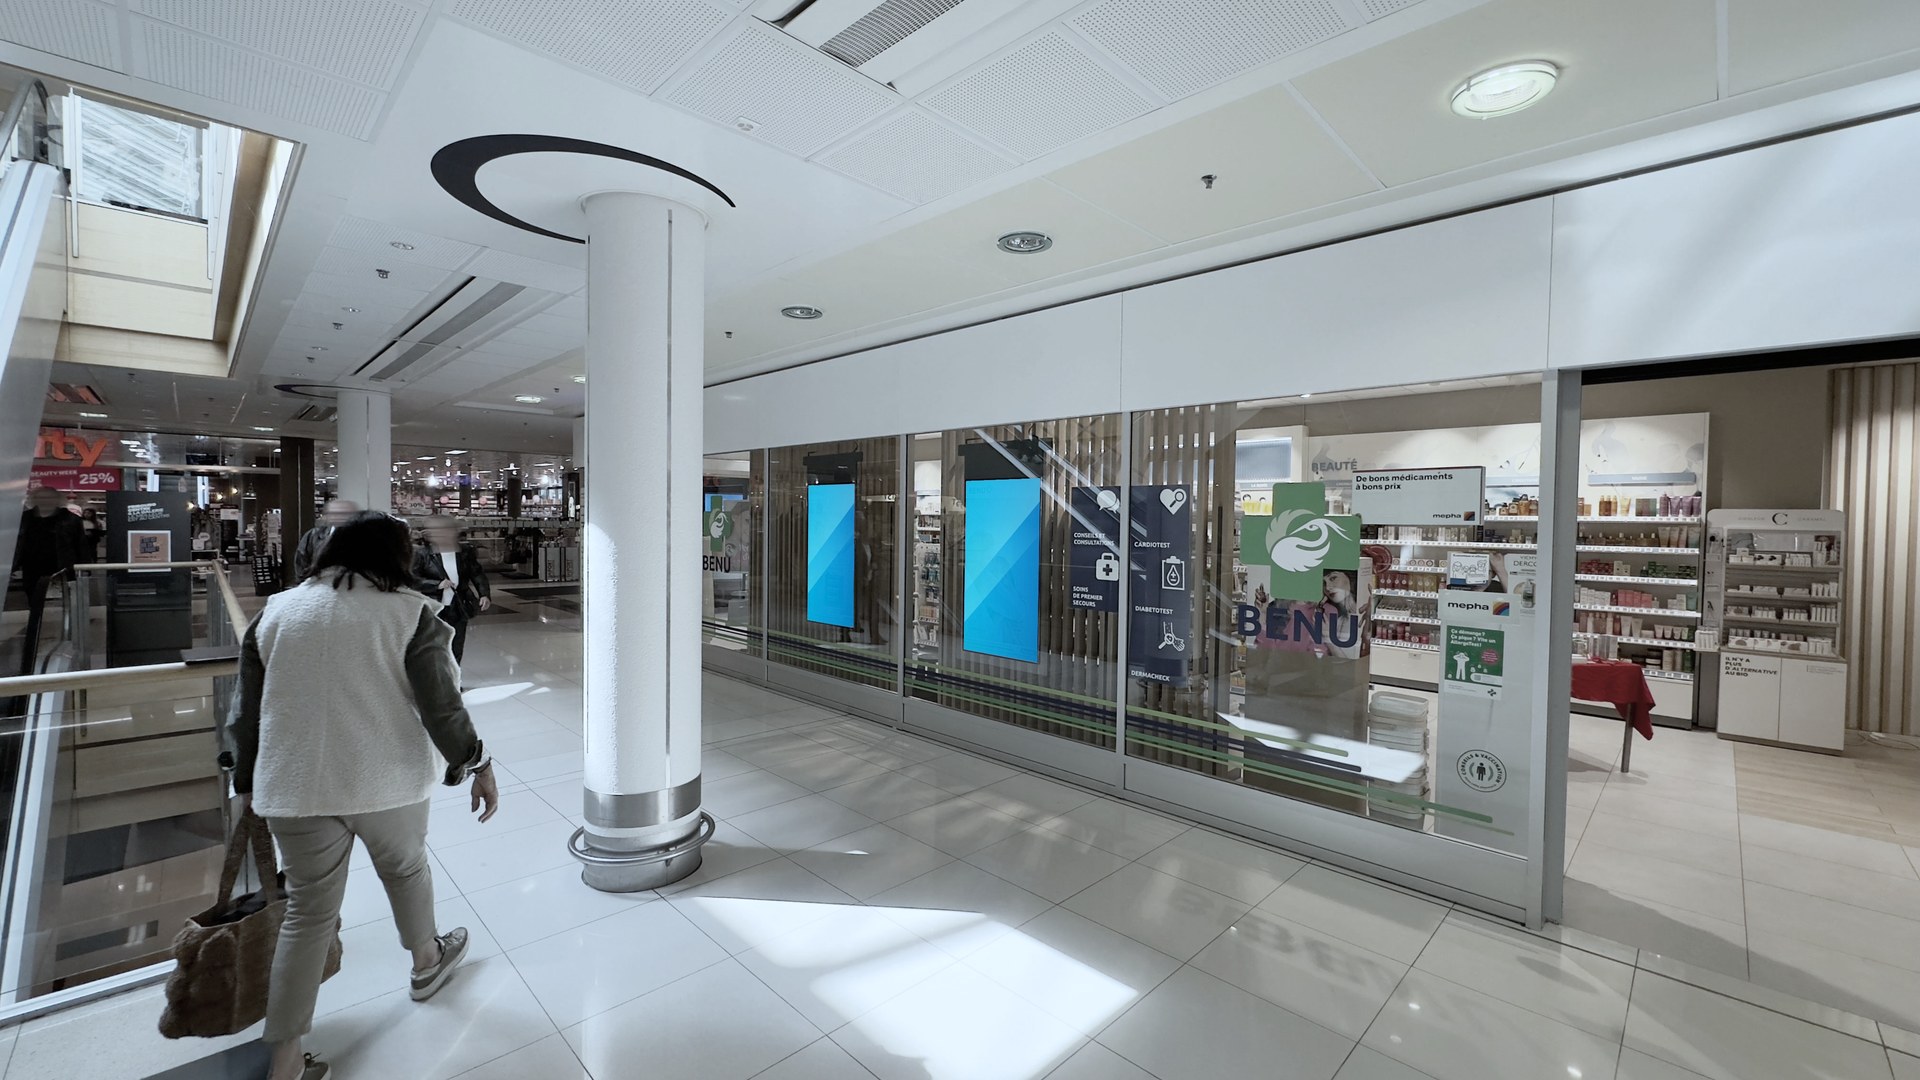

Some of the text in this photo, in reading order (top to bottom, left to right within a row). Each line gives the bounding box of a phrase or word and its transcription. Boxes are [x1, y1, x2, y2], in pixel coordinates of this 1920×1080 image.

[1312, 459, 1358, 472] BEAUTÉ
[79, 472, 115, 484] 25%
[1355, 475, 1367, 483] De
[1391, 472, 1454, 482] médicaments
[1384, 483, 1402, 491] prix
[1771, 512, 1788, 526] C
[1073, 532, 1099, 540] CONSEILS
[1134, 541, 1171, 549] CARDIOTEST
[702, 555, 731, 573] BENU
[1073, 600, 1096, 608] SECOURS
[1447, 602, 1489, 610] mepha
[1135, 605, 1174, 615] DIABETOTEST
[1238, 604, 1358, 648] BENU
[1131, 670, 1170, 681] DERMACHECK
